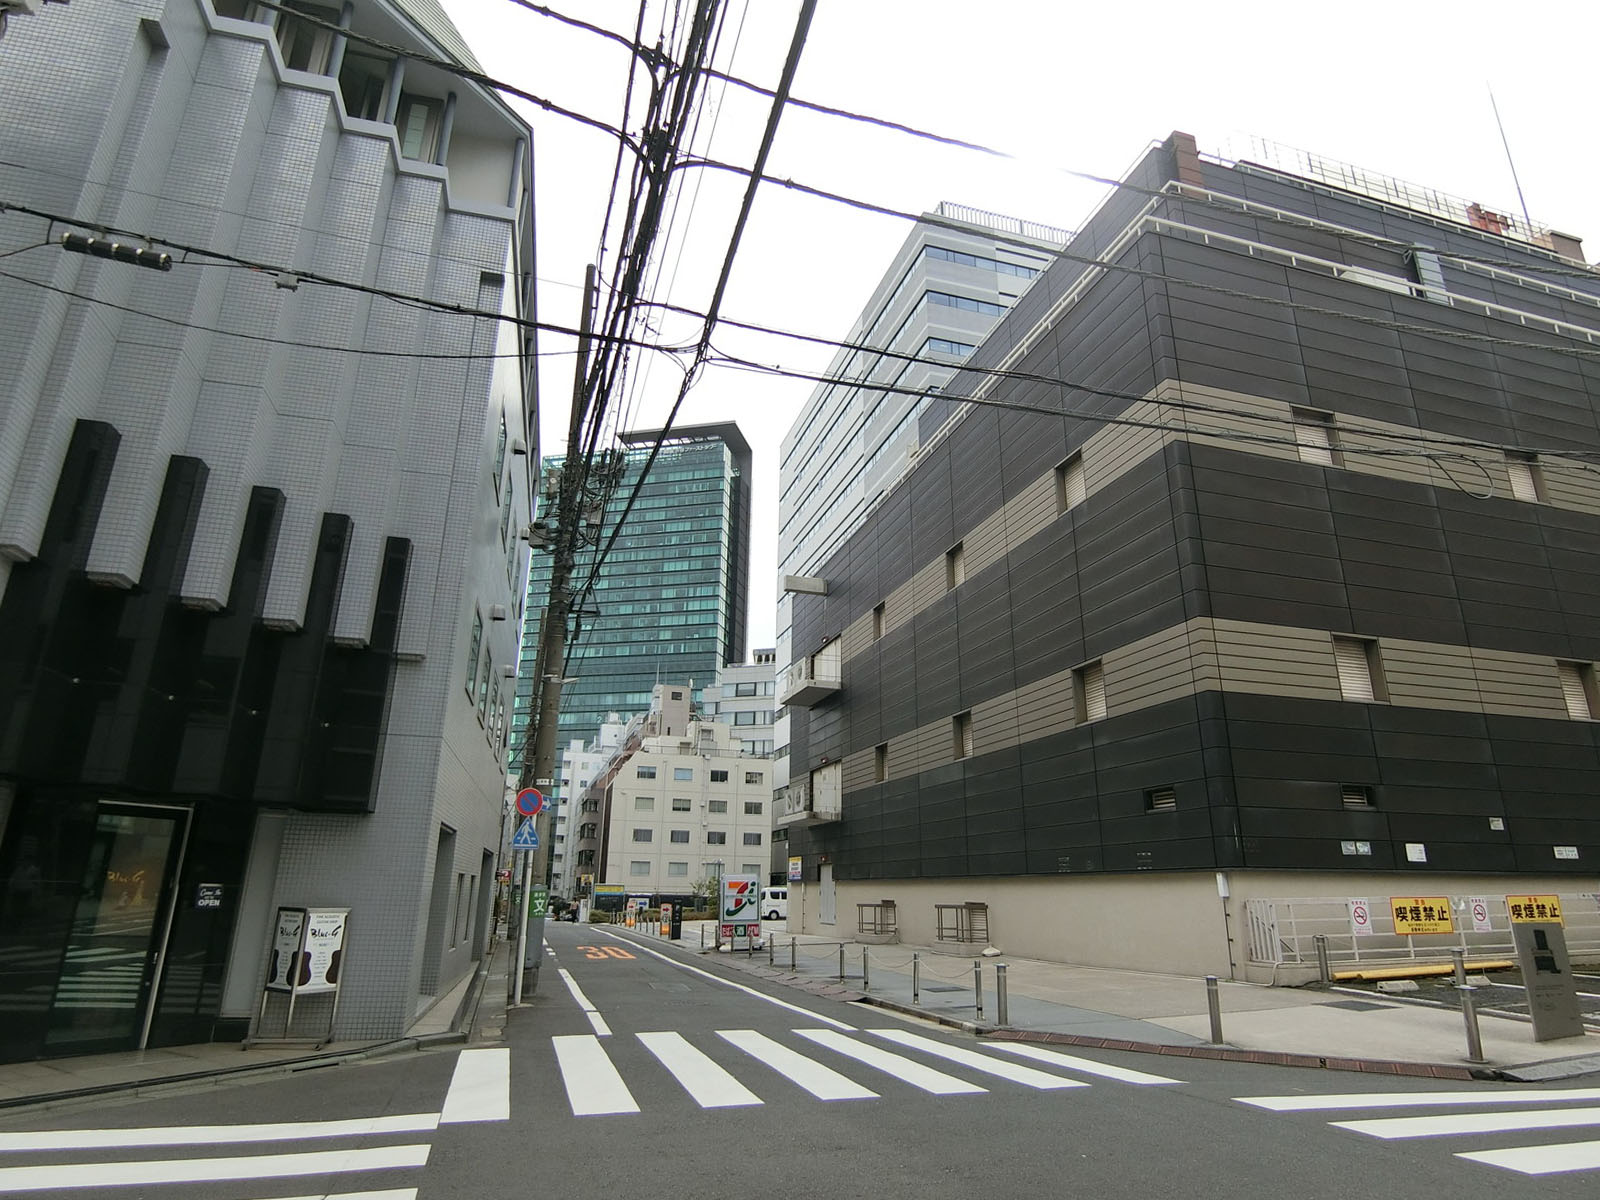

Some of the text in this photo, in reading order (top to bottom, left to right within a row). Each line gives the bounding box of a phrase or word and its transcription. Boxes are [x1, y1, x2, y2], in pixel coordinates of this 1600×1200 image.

[198, 899, 221, 907] OPEN
[533, 898, 545, 912] 文
[1395, 905, 1449, 922] 喫煙禁止
[1511, 903, 1560, 919] 喫煙禁止
[310, 925, 342, 938] Blue-G
[577, 945, 637, 959] 30
